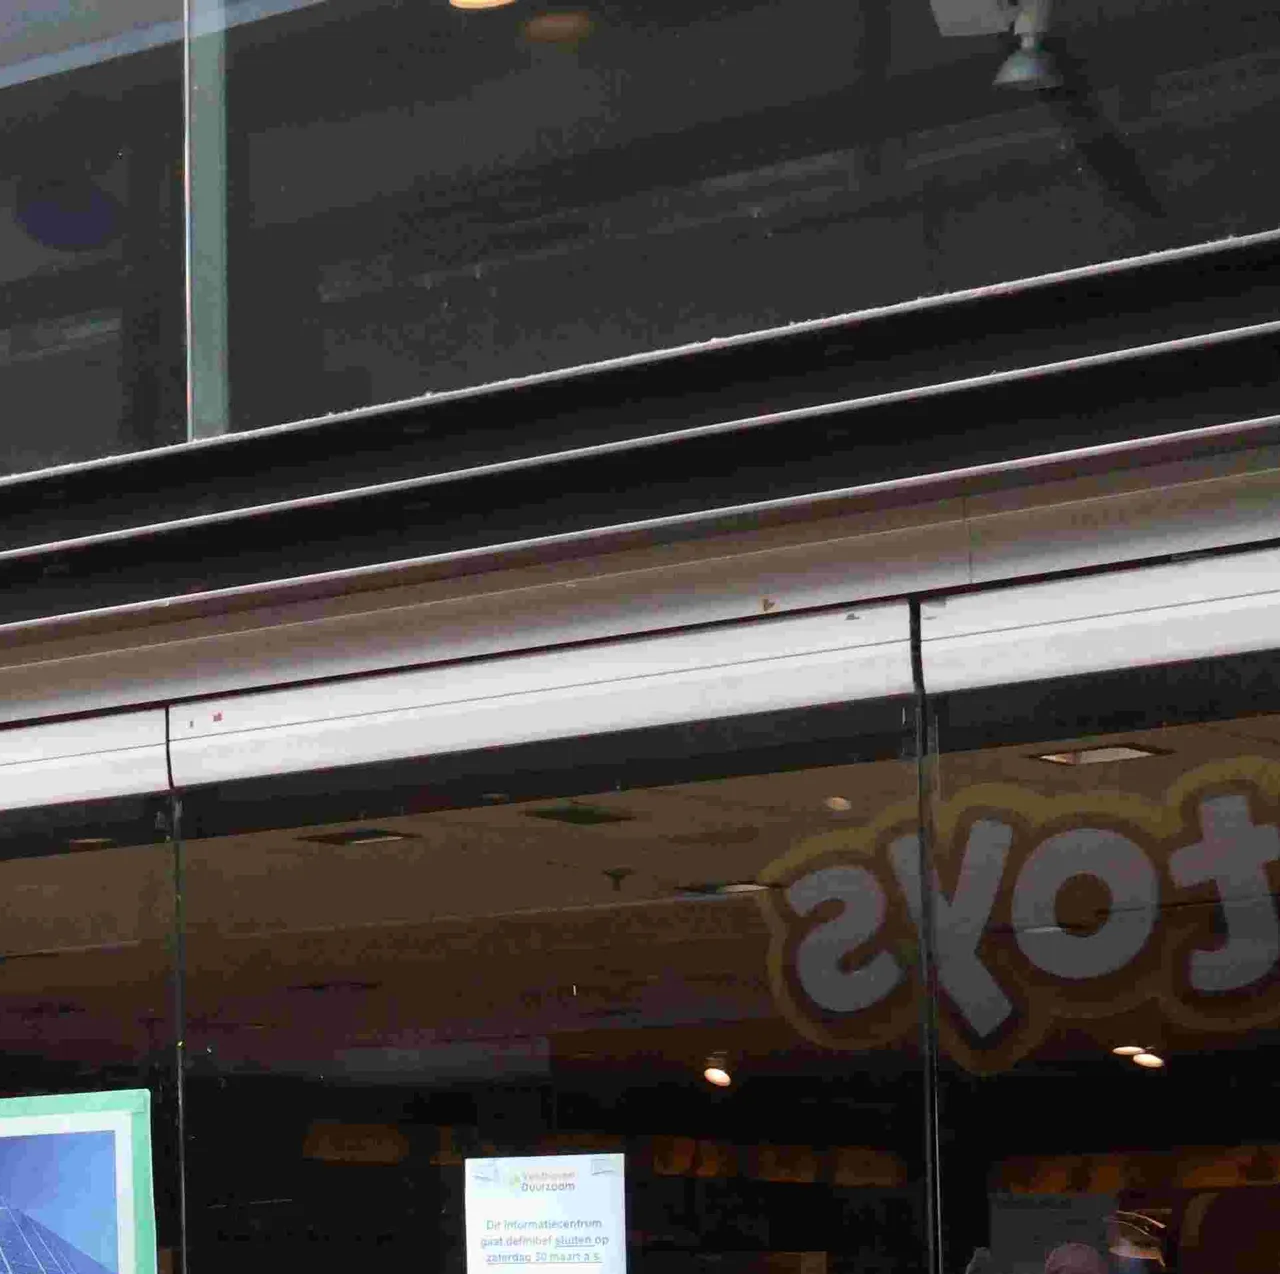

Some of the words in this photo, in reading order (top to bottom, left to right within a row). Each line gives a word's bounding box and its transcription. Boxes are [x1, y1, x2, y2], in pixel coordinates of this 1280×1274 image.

[486, 1220, 501, 1230] Dit
[503, 1219, 603, 1230] informatiecentrum
[555, 1235, 592, 1246] sluiten
[594, 1236, 610, 1246] op
[486, 1252, 532, 1263] zaterdag
[550, 1252, 581, 1262] maart
